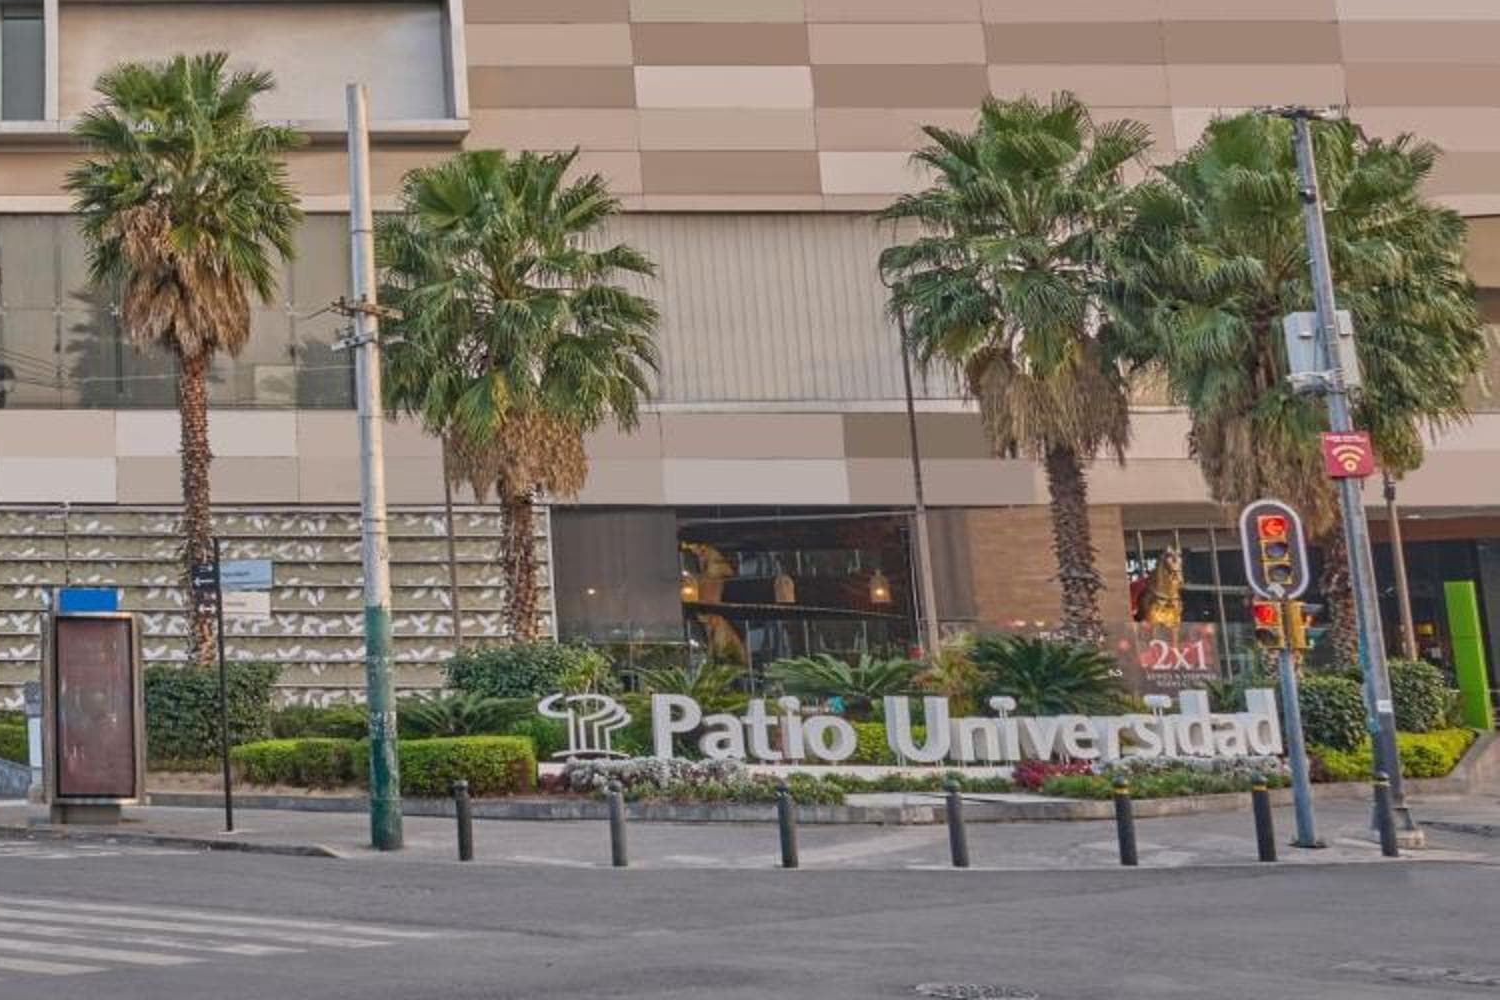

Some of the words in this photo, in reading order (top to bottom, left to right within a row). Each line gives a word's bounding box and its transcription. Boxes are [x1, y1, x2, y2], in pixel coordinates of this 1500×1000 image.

[1149, 638, 1207, 670] 2x1
[650, 693, 858, 762] Patio
[883, 688, 1284, 763] Universidad
